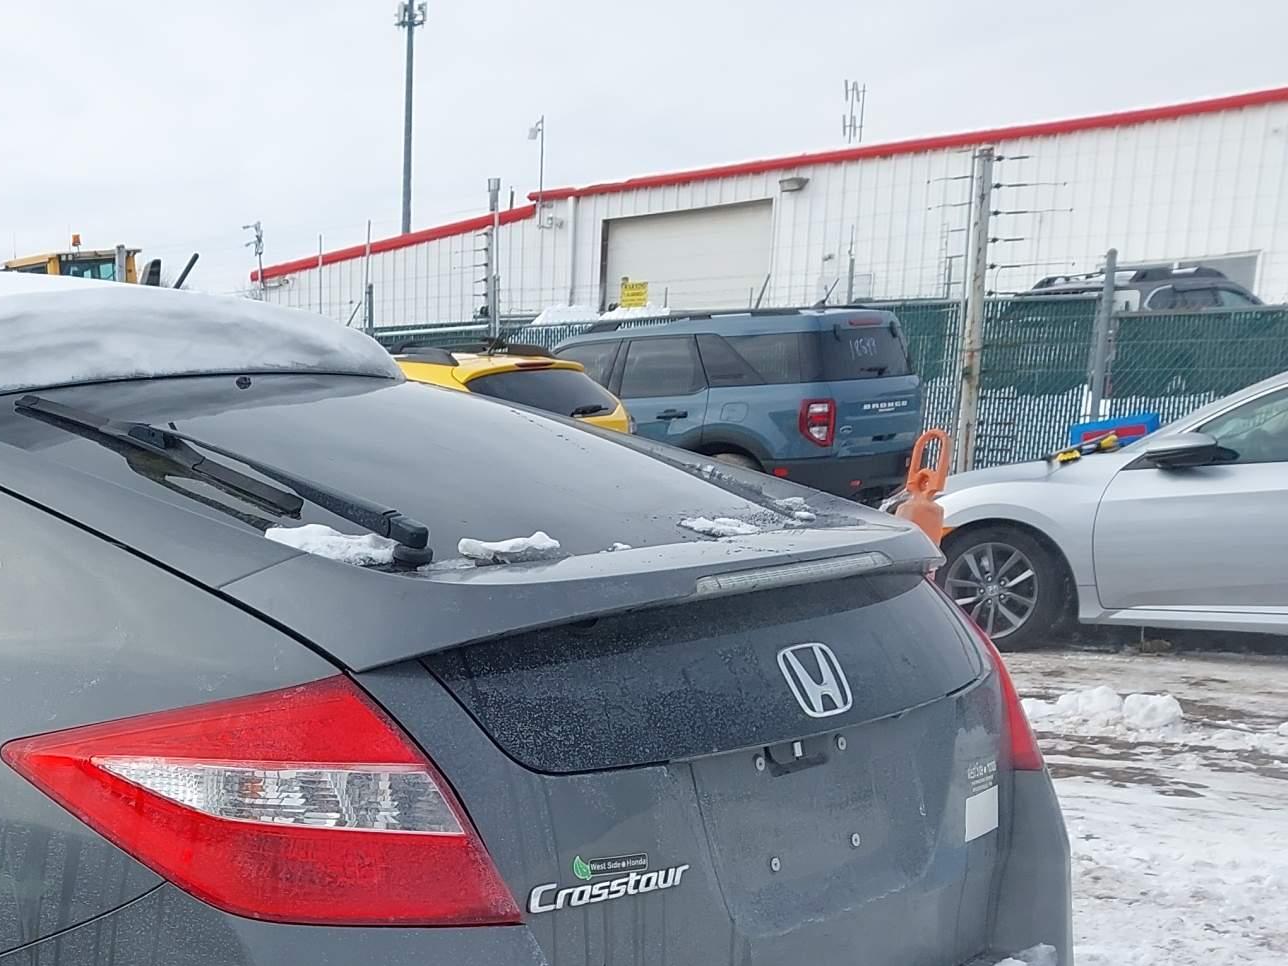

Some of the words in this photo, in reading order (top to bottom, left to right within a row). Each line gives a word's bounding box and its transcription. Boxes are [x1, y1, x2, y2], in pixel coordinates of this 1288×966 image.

[863, 400, 908, 410] BRONCO
[590, 862, 607, 871] West
[607, 860, 621, 869] Side
[626, 857, 647, 867] Honda
[528, 864, 690, 914] Crosstour
